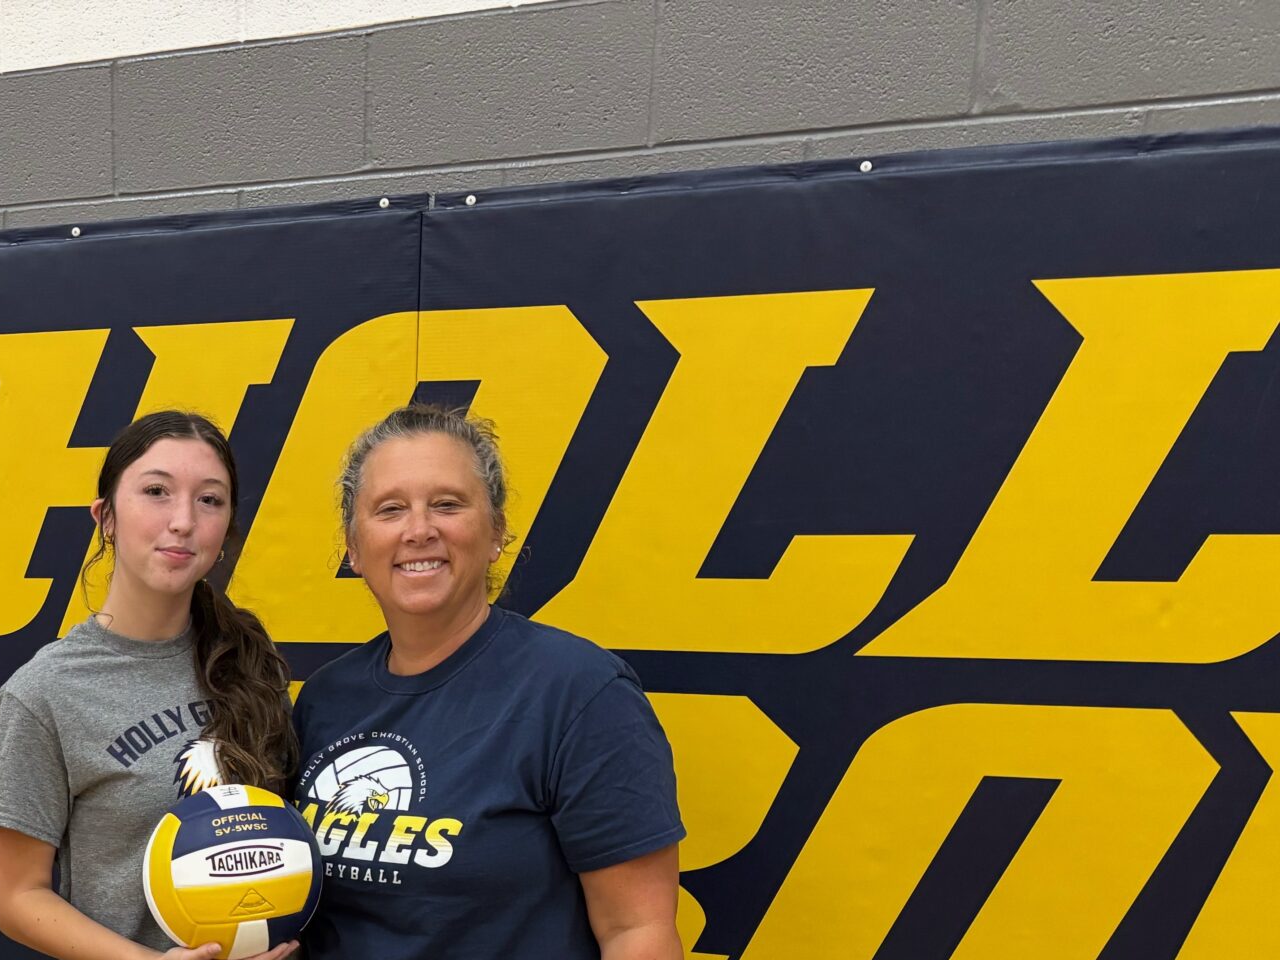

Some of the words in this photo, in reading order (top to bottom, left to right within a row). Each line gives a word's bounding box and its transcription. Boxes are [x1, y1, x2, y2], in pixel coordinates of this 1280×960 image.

[106, 705, 187, 768] HOLLY
[300, 752, 325, 786] HOLLY
[328, 732, 366, 752] GROVE
[371, 731, 418, 755] CHRISTIAN
[415, 757, 428, 803] SCHOOL
[211, 812, 267, 827] OFFICIAL
[214, 823, 269, 837] SV-5WSC
[296, 800, 464, 869] AGLES
[206, 847, 283, 872] TACHIKARA
[325, 862, 402, 885] EYBALL
